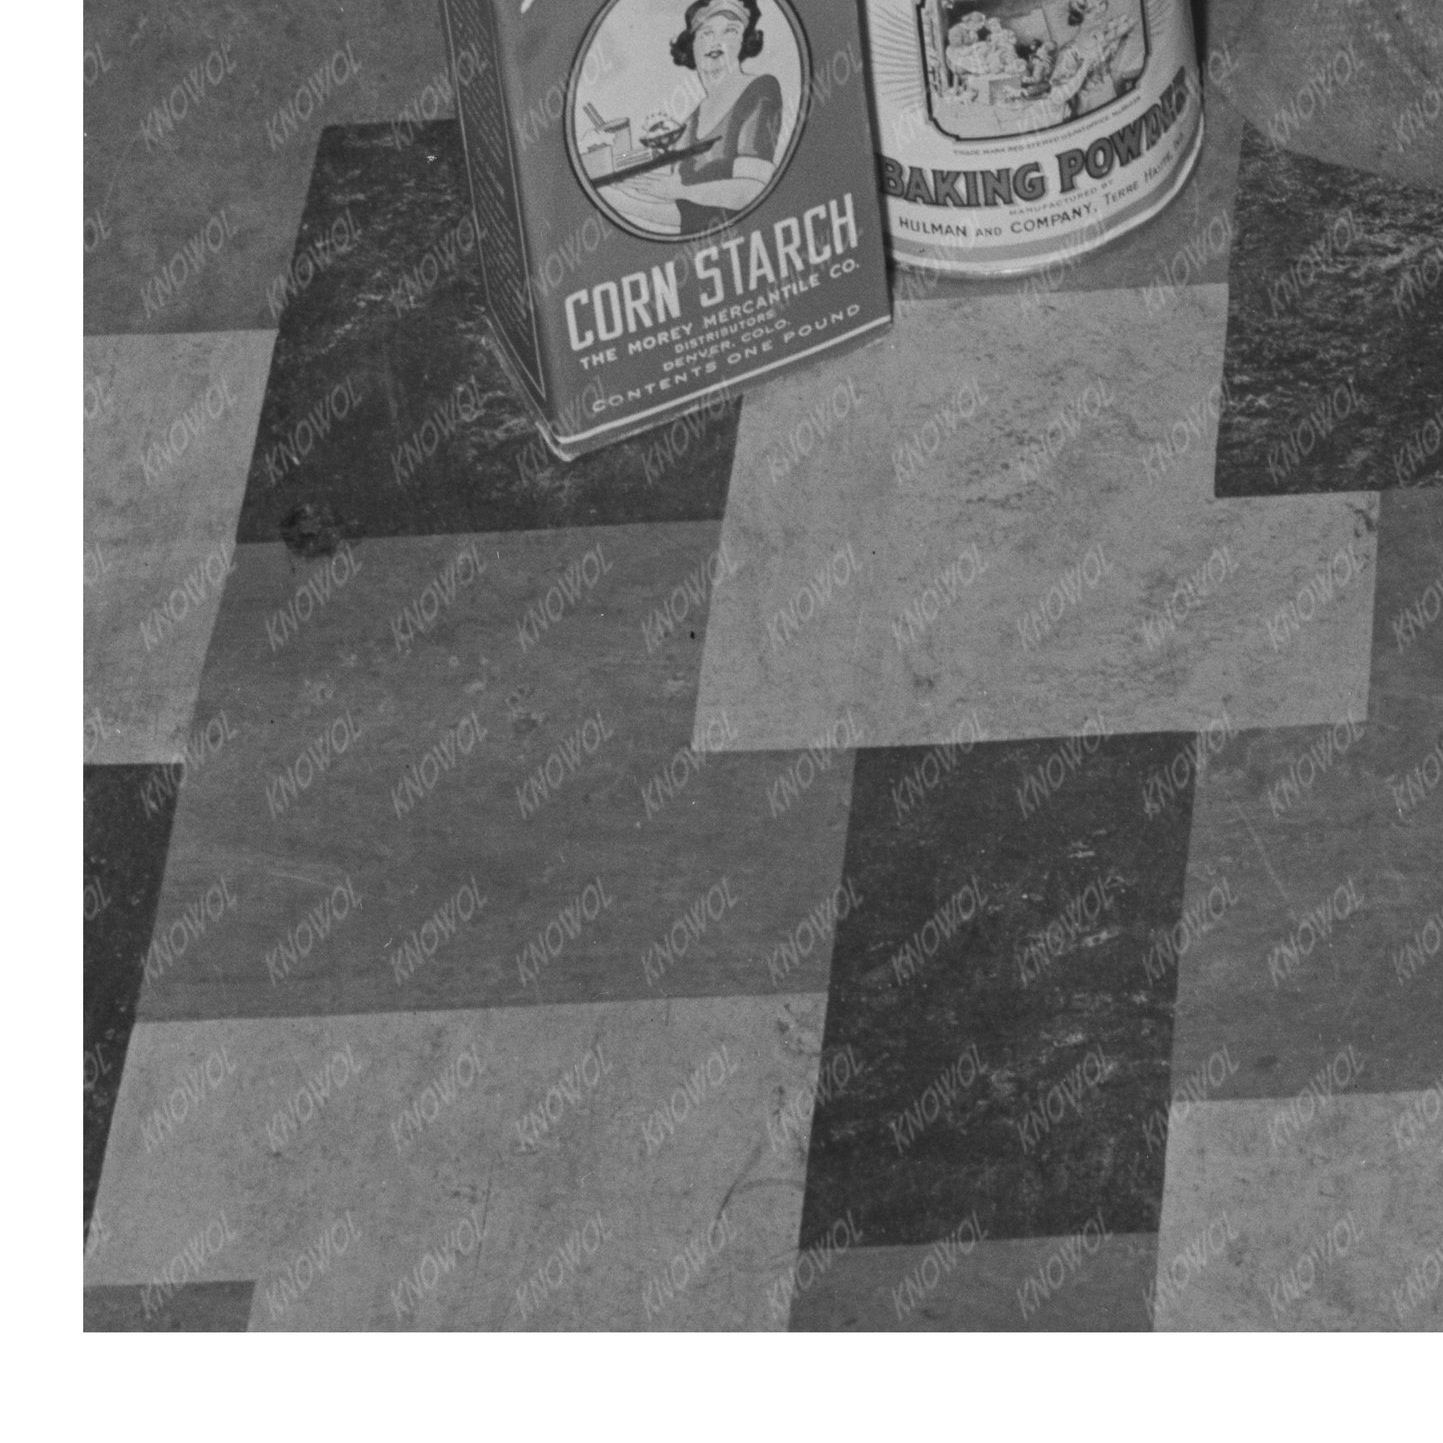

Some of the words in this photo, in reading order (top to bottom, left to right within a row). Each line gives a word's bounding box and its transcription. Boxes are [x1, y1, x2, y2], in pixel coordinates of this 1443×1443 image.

[879, 153, 1047, 209] BAKING
[898, 216, 968, 238] HULMAN
[974, 225, 1003, 238] AND
[1009, 203, 1099, 235] COMPANY,
[564, 259, 682, 352] CORN
[693, 192, 859, 309] STARCH
[579, 348, 619, 371] THE
[627, 321, 694, 357] MOREY
[702, 273, 821, 331] MERCANTILE
[829, 258, 860, 280] CO.
[673, 308, 777, 355] DISTRIBUTORS
[740, 318, 792, 344] COLO.
[591, 360, 719, 414] CONTENTS
[726, 339, 774, 366] ONE
[783, 302, 861, 345] POUND
